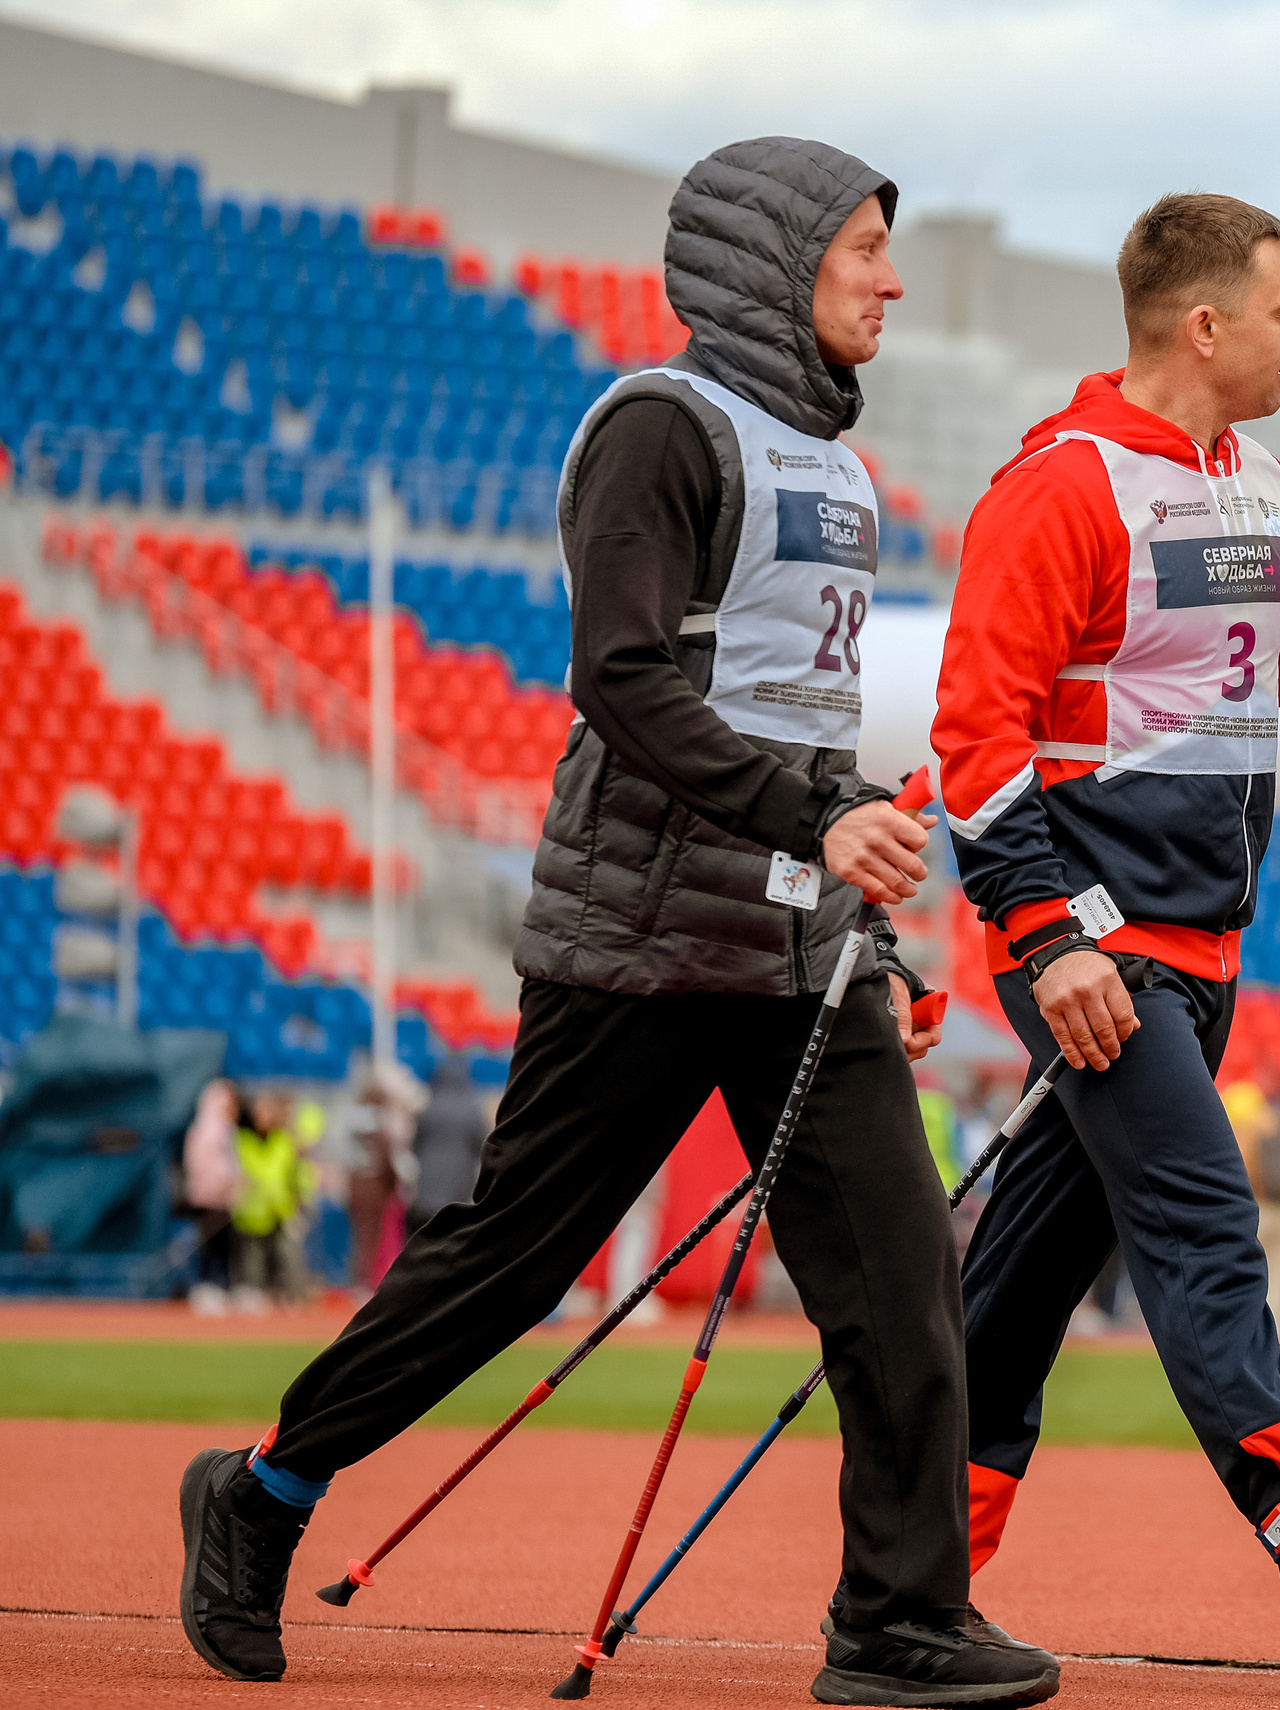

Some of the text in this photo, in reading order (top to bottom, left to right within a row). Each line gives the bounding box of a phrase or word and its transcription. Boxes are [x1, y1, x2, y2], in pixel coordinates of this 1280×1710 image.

[1203, 546, 1271, 563] СЕВЕРНАЯ
[1208, 584, 1276, 595] НОВЫЙ ОБРАЗ ЖИЗНИ
[814, 584, 866, 676] 28
[1221, 621, 1256, 702] 3
[762, 1108, 793, 1172] ОБРАЗ
[733, 1185, 764, 1252] ЖИЗНИ
